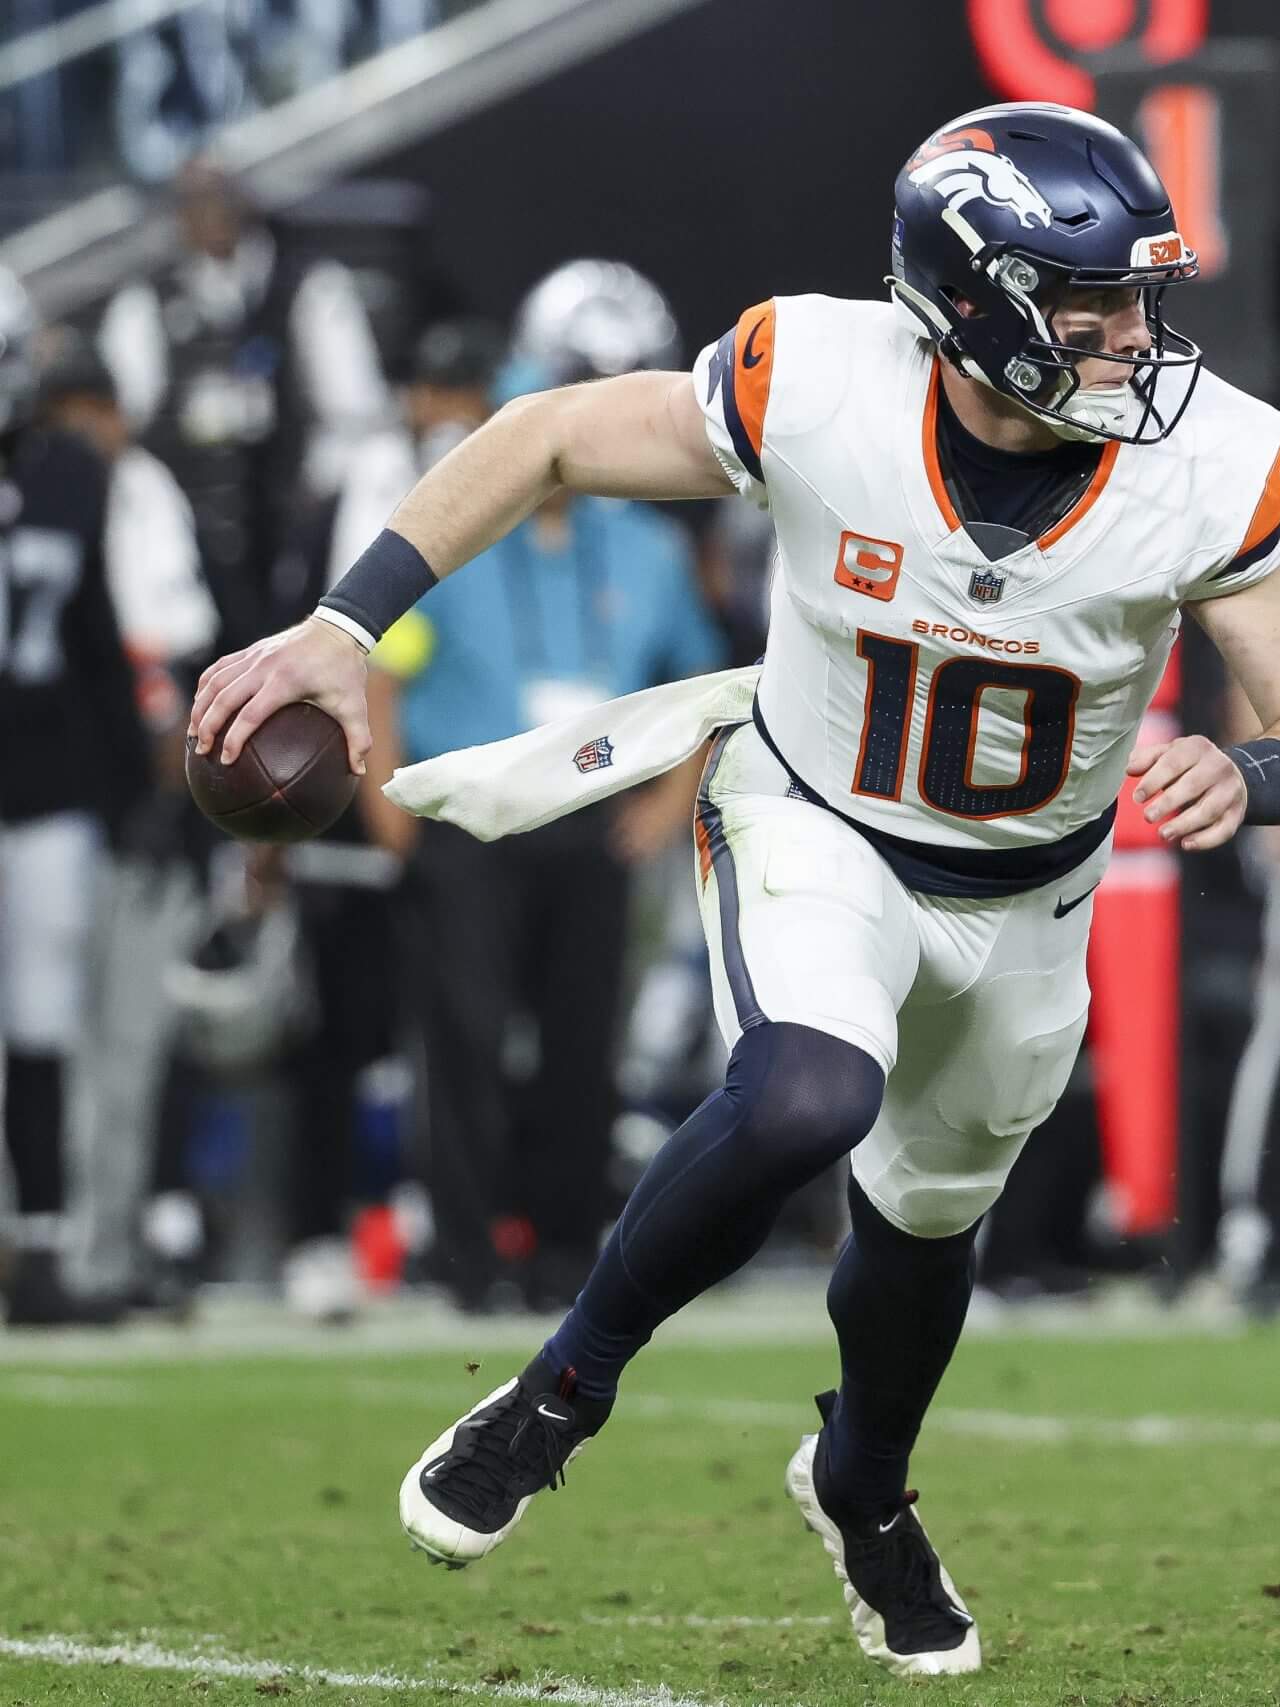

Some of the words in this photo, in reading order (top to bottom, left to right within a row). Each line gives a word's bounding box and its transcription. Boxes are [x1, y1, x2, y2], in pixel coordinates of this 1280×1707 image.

[843, 537, 897, 583] C
[912, 618, 1040, 654] BRONCOS
[851, 627, 1082, 821] 10
